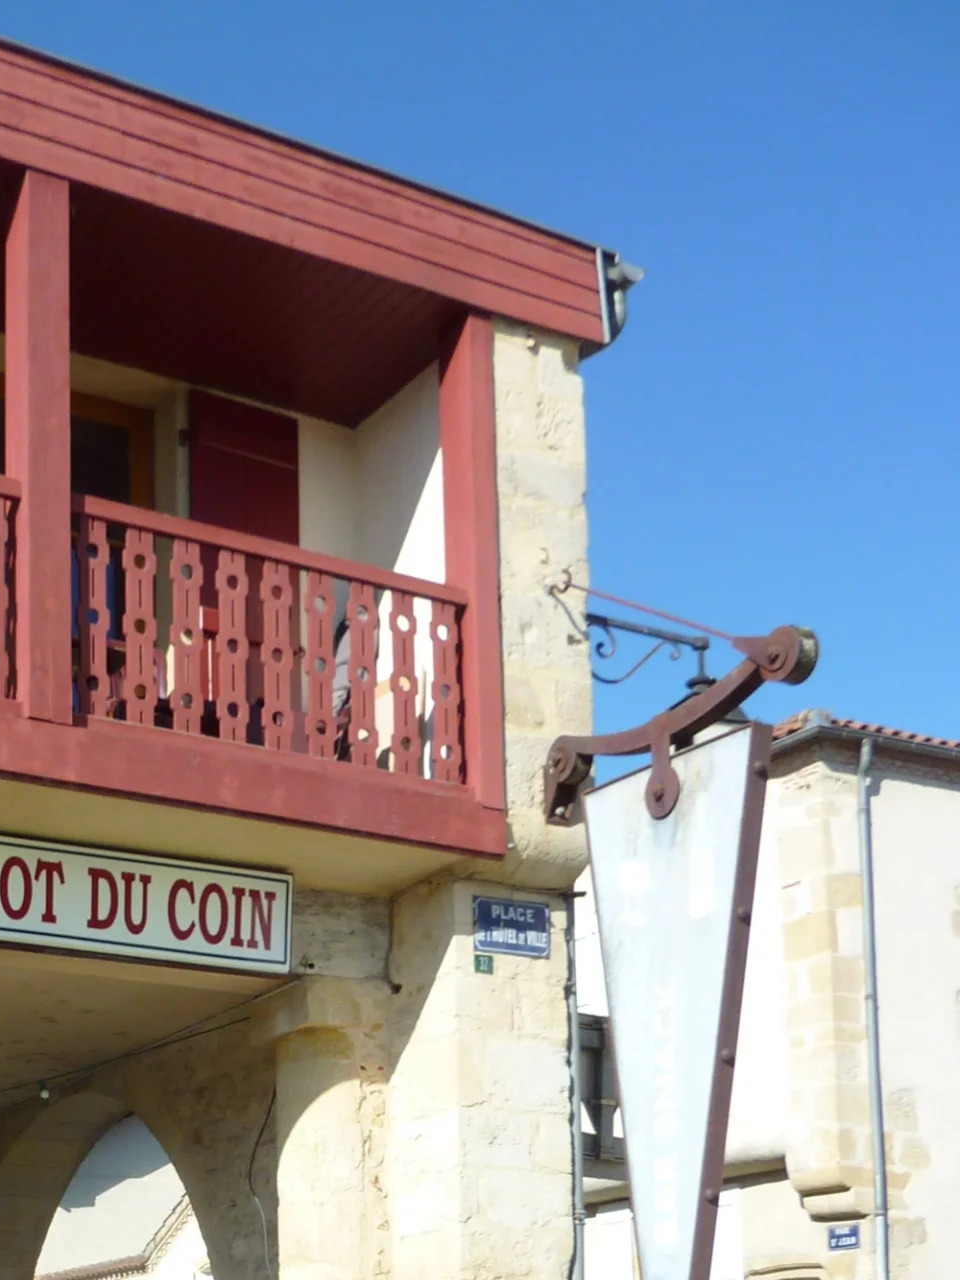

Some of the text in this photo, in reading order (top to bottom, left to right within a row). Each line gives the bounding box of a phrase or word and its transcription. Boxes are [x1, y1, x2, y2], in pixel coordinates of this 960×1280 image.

[86, 867, 152, 935] DU
[167, 878, 276, 951] COIN
[491, 904, 535, 922] PLACE
[651, 978, 678, 1138] SNACK
